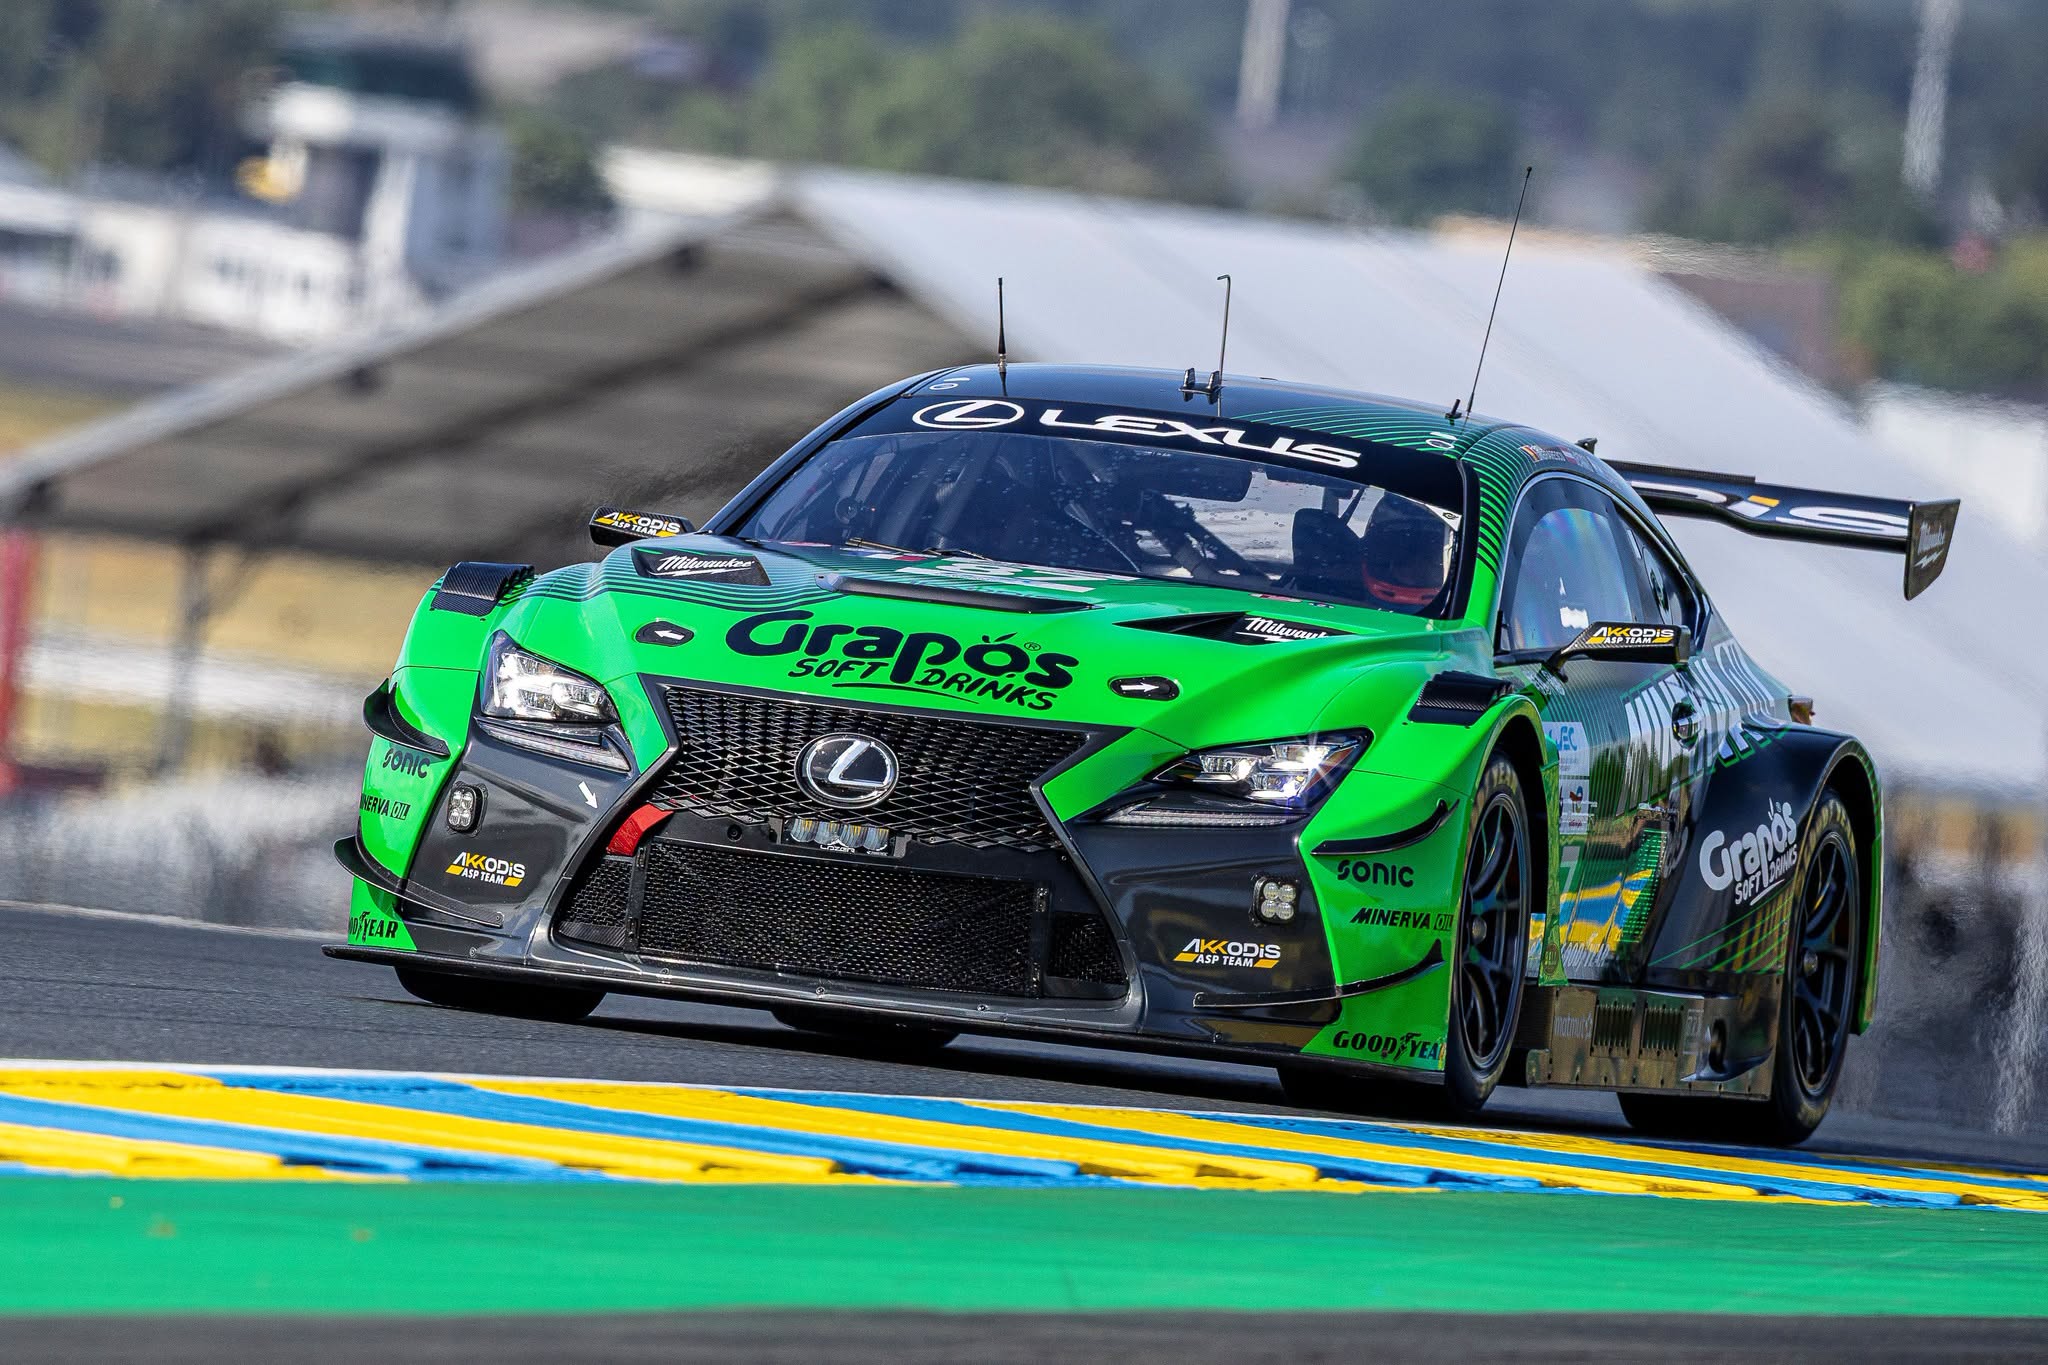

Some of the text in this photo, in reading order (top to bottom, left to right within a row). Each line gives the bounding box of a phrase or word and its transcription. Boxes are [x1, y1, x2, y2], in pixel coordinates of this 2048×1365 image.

[1039, 408, 1361, 468] LEXUS
[611, 521, 657, 535] ASP TEAM
[657, 554, 755, 573] Milwaukee
[1604, 636, 1623, 644] ASP
[788, 657, 1059, 711] SOFT DRINKS
[461, 868, 504, 885] ASP TEAM
[1735, 844, 1797, 905] SOFT DRINKS
[1350, 907, 1430, 929] MINERVA
[1196, 954, 1254, 967] ASP TEAM
